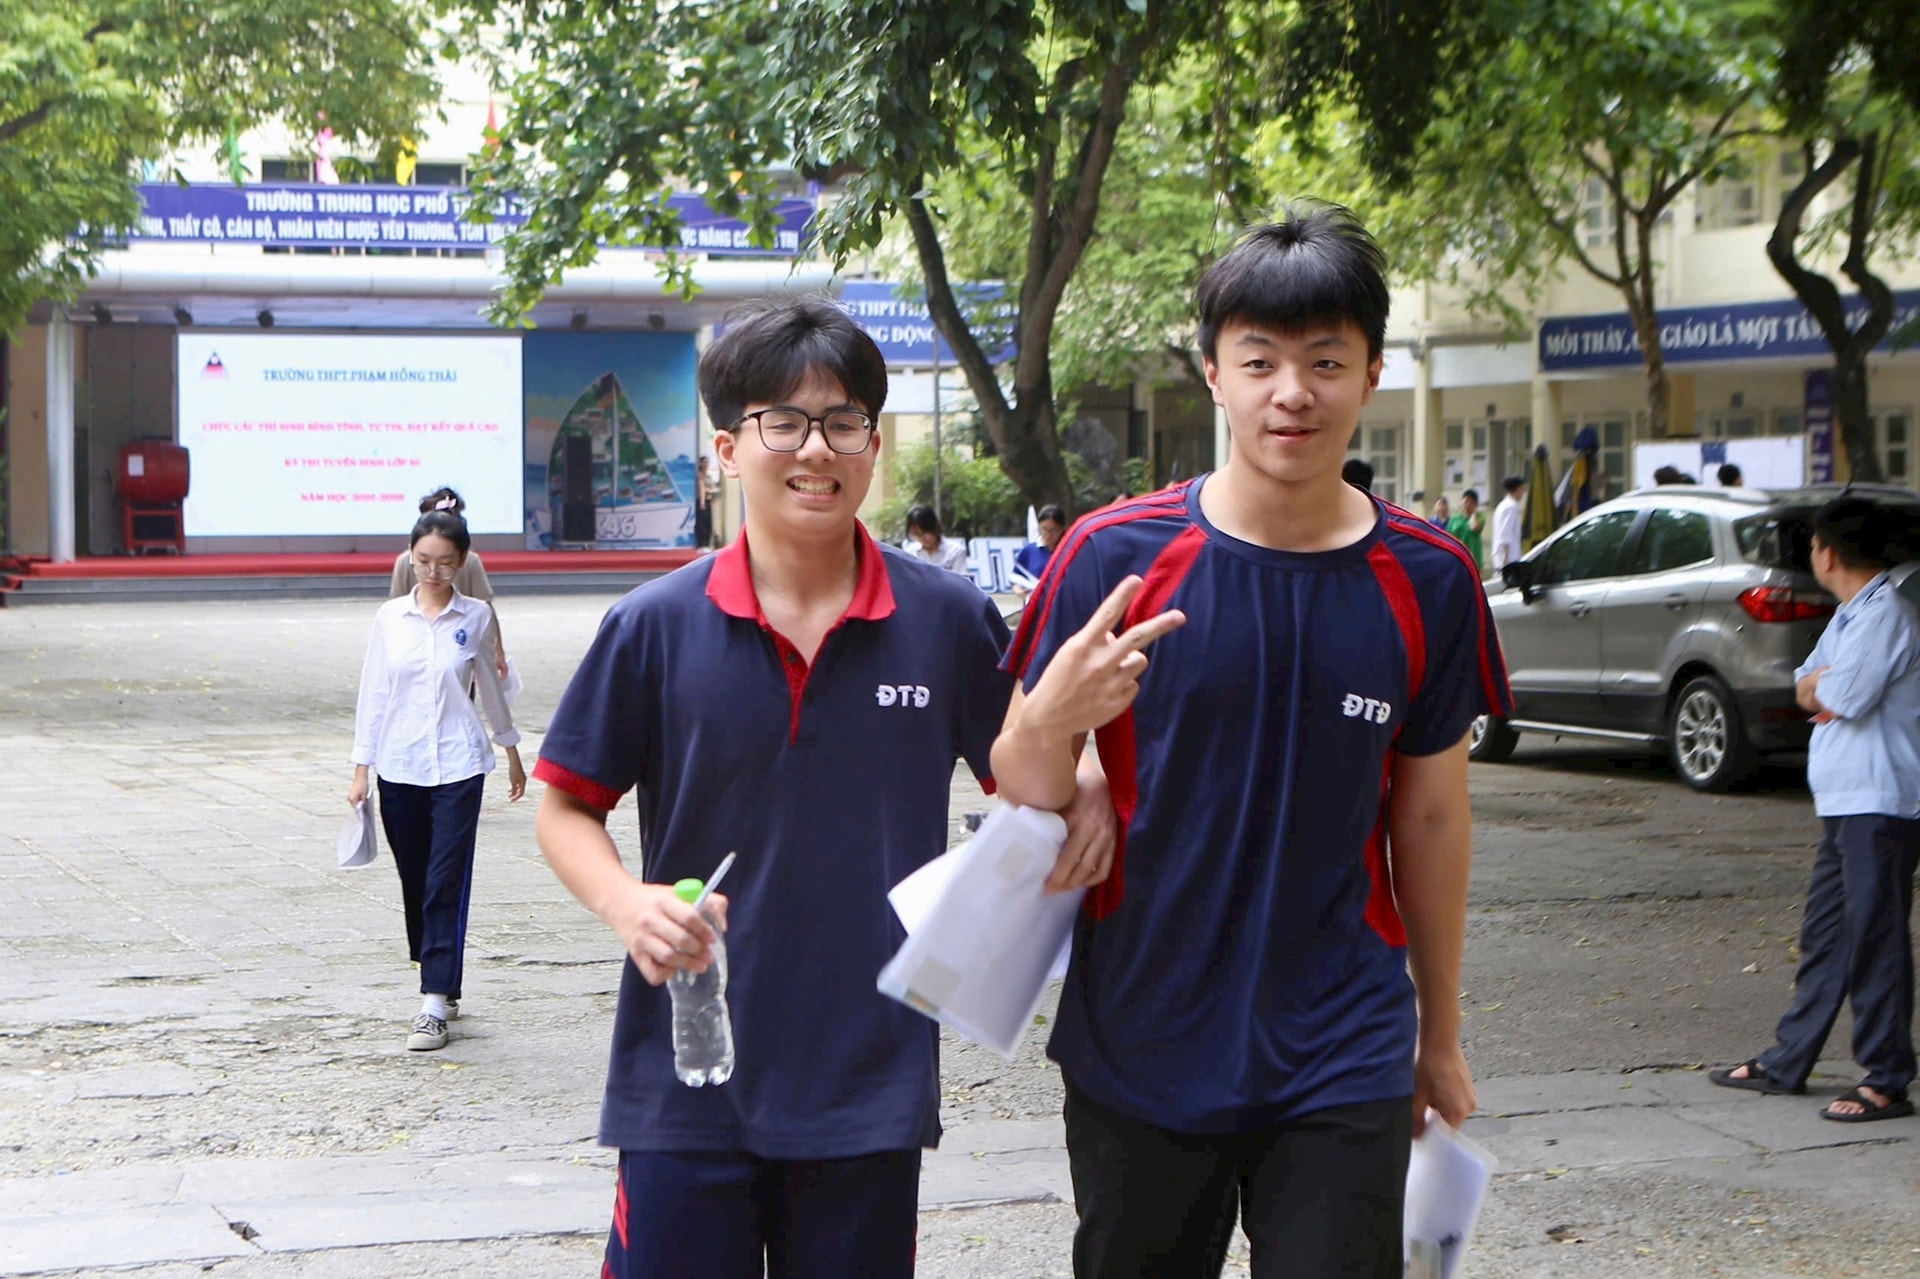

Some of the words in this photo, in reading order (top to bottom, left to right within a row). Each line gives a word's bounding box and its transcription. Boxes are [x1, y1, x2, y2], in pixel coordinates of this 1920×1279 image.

[246, 189, 313, 212] TRƯỜNG
[316, 193, 373, 213] TRUNG
[376, 194, 410, 217] HỌC
[278, 216, 314, 239] NHÂN
[315, 217, 345, 240] VIÊN
[858, 300, 897, 317] THPT
[1658, 316, 1707, 350] GIÁO
[263, 367, 315, 382] TRƯỜNG
[317, 369, 349, 382] THPT
[350, 369, 387, 384] PHẠM
[389, 367, 426, 382] HỒNG
[875, 684, 931, 708] ĐTĐ
[1341, 693, 1391, 724] ĐTĐ
